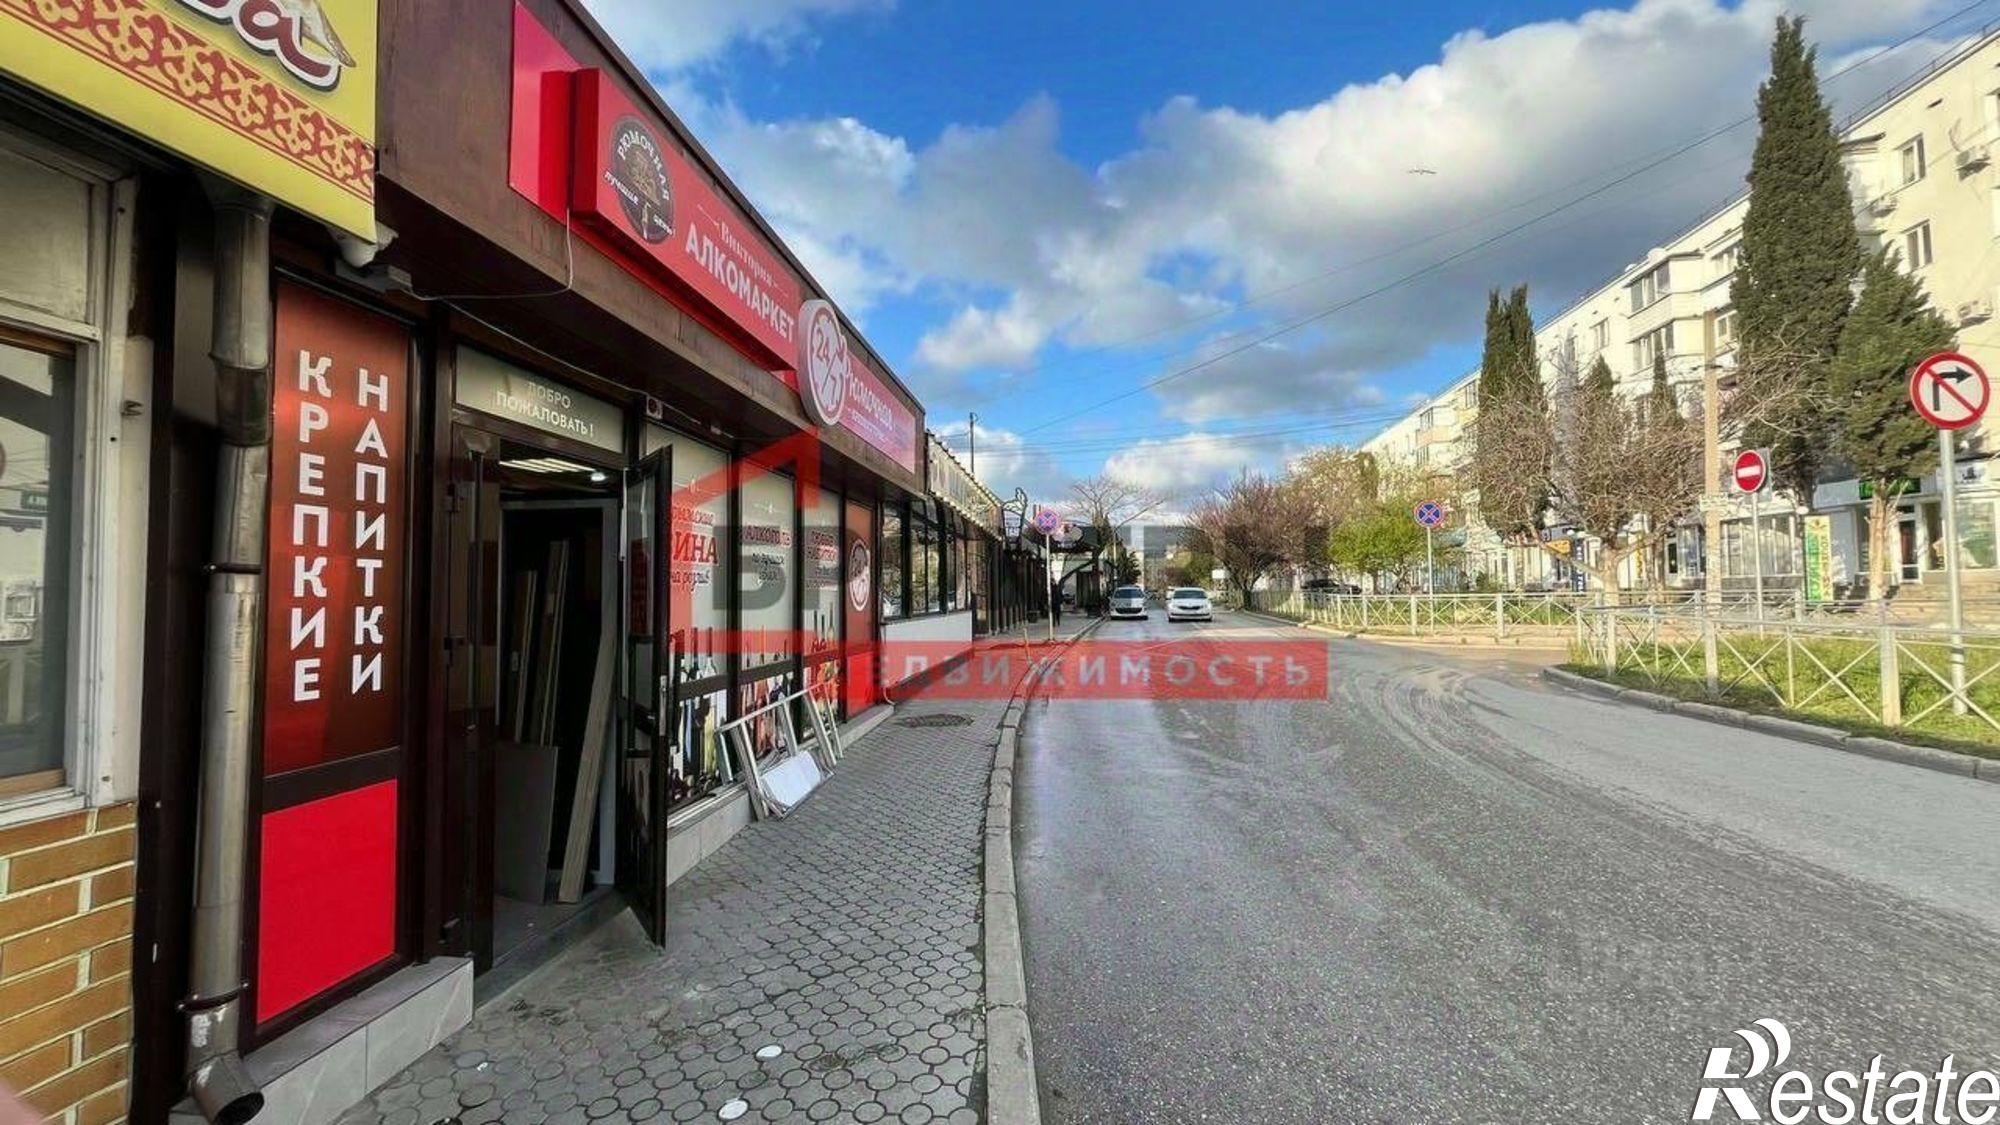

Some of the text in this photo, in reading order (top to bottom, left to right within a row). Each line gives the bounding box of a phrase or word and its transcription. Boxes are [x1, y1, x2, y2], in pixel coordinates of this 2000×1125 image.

[685, 222, 795, 343] АЛКОМАРКЕТ
[526, 380, 572, 410] ДОБРО
[290, 349, 333, 702] КРЕПКИЕ
[351, 367, 390, 695] НАПИТКИ
